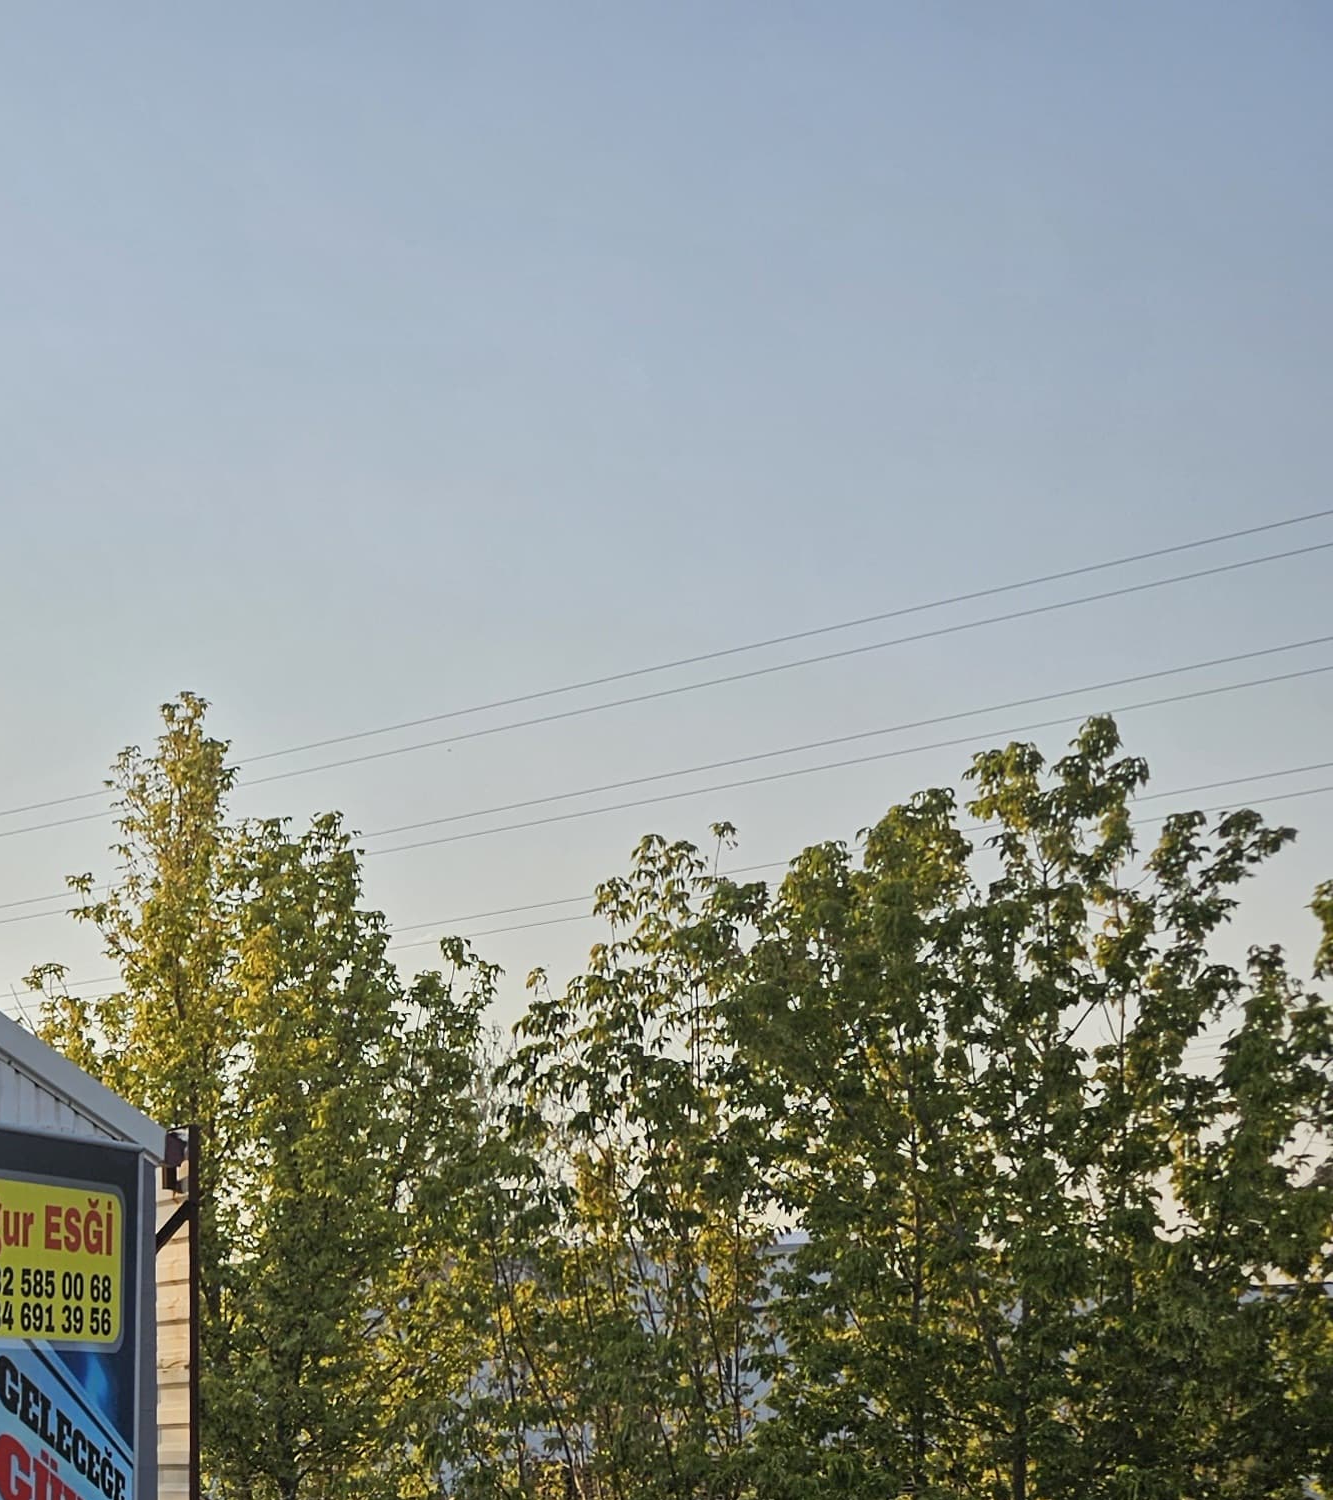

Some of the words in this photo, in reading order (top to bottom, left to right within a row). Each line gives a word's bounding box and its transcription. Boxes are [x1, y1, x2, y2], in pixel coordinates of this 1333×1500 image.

[44, 1198, 113, 1257] ESĞİ
[20, 1268, 55, 1299] 585
[62, 1271, 83, 1301] 00
[90, 1274, 111, 1304] 68
[20, 1302, 55, 1333] 691
[61, 1305, 83, 1335] 39
[89, 1308, 111, 1337] 56
